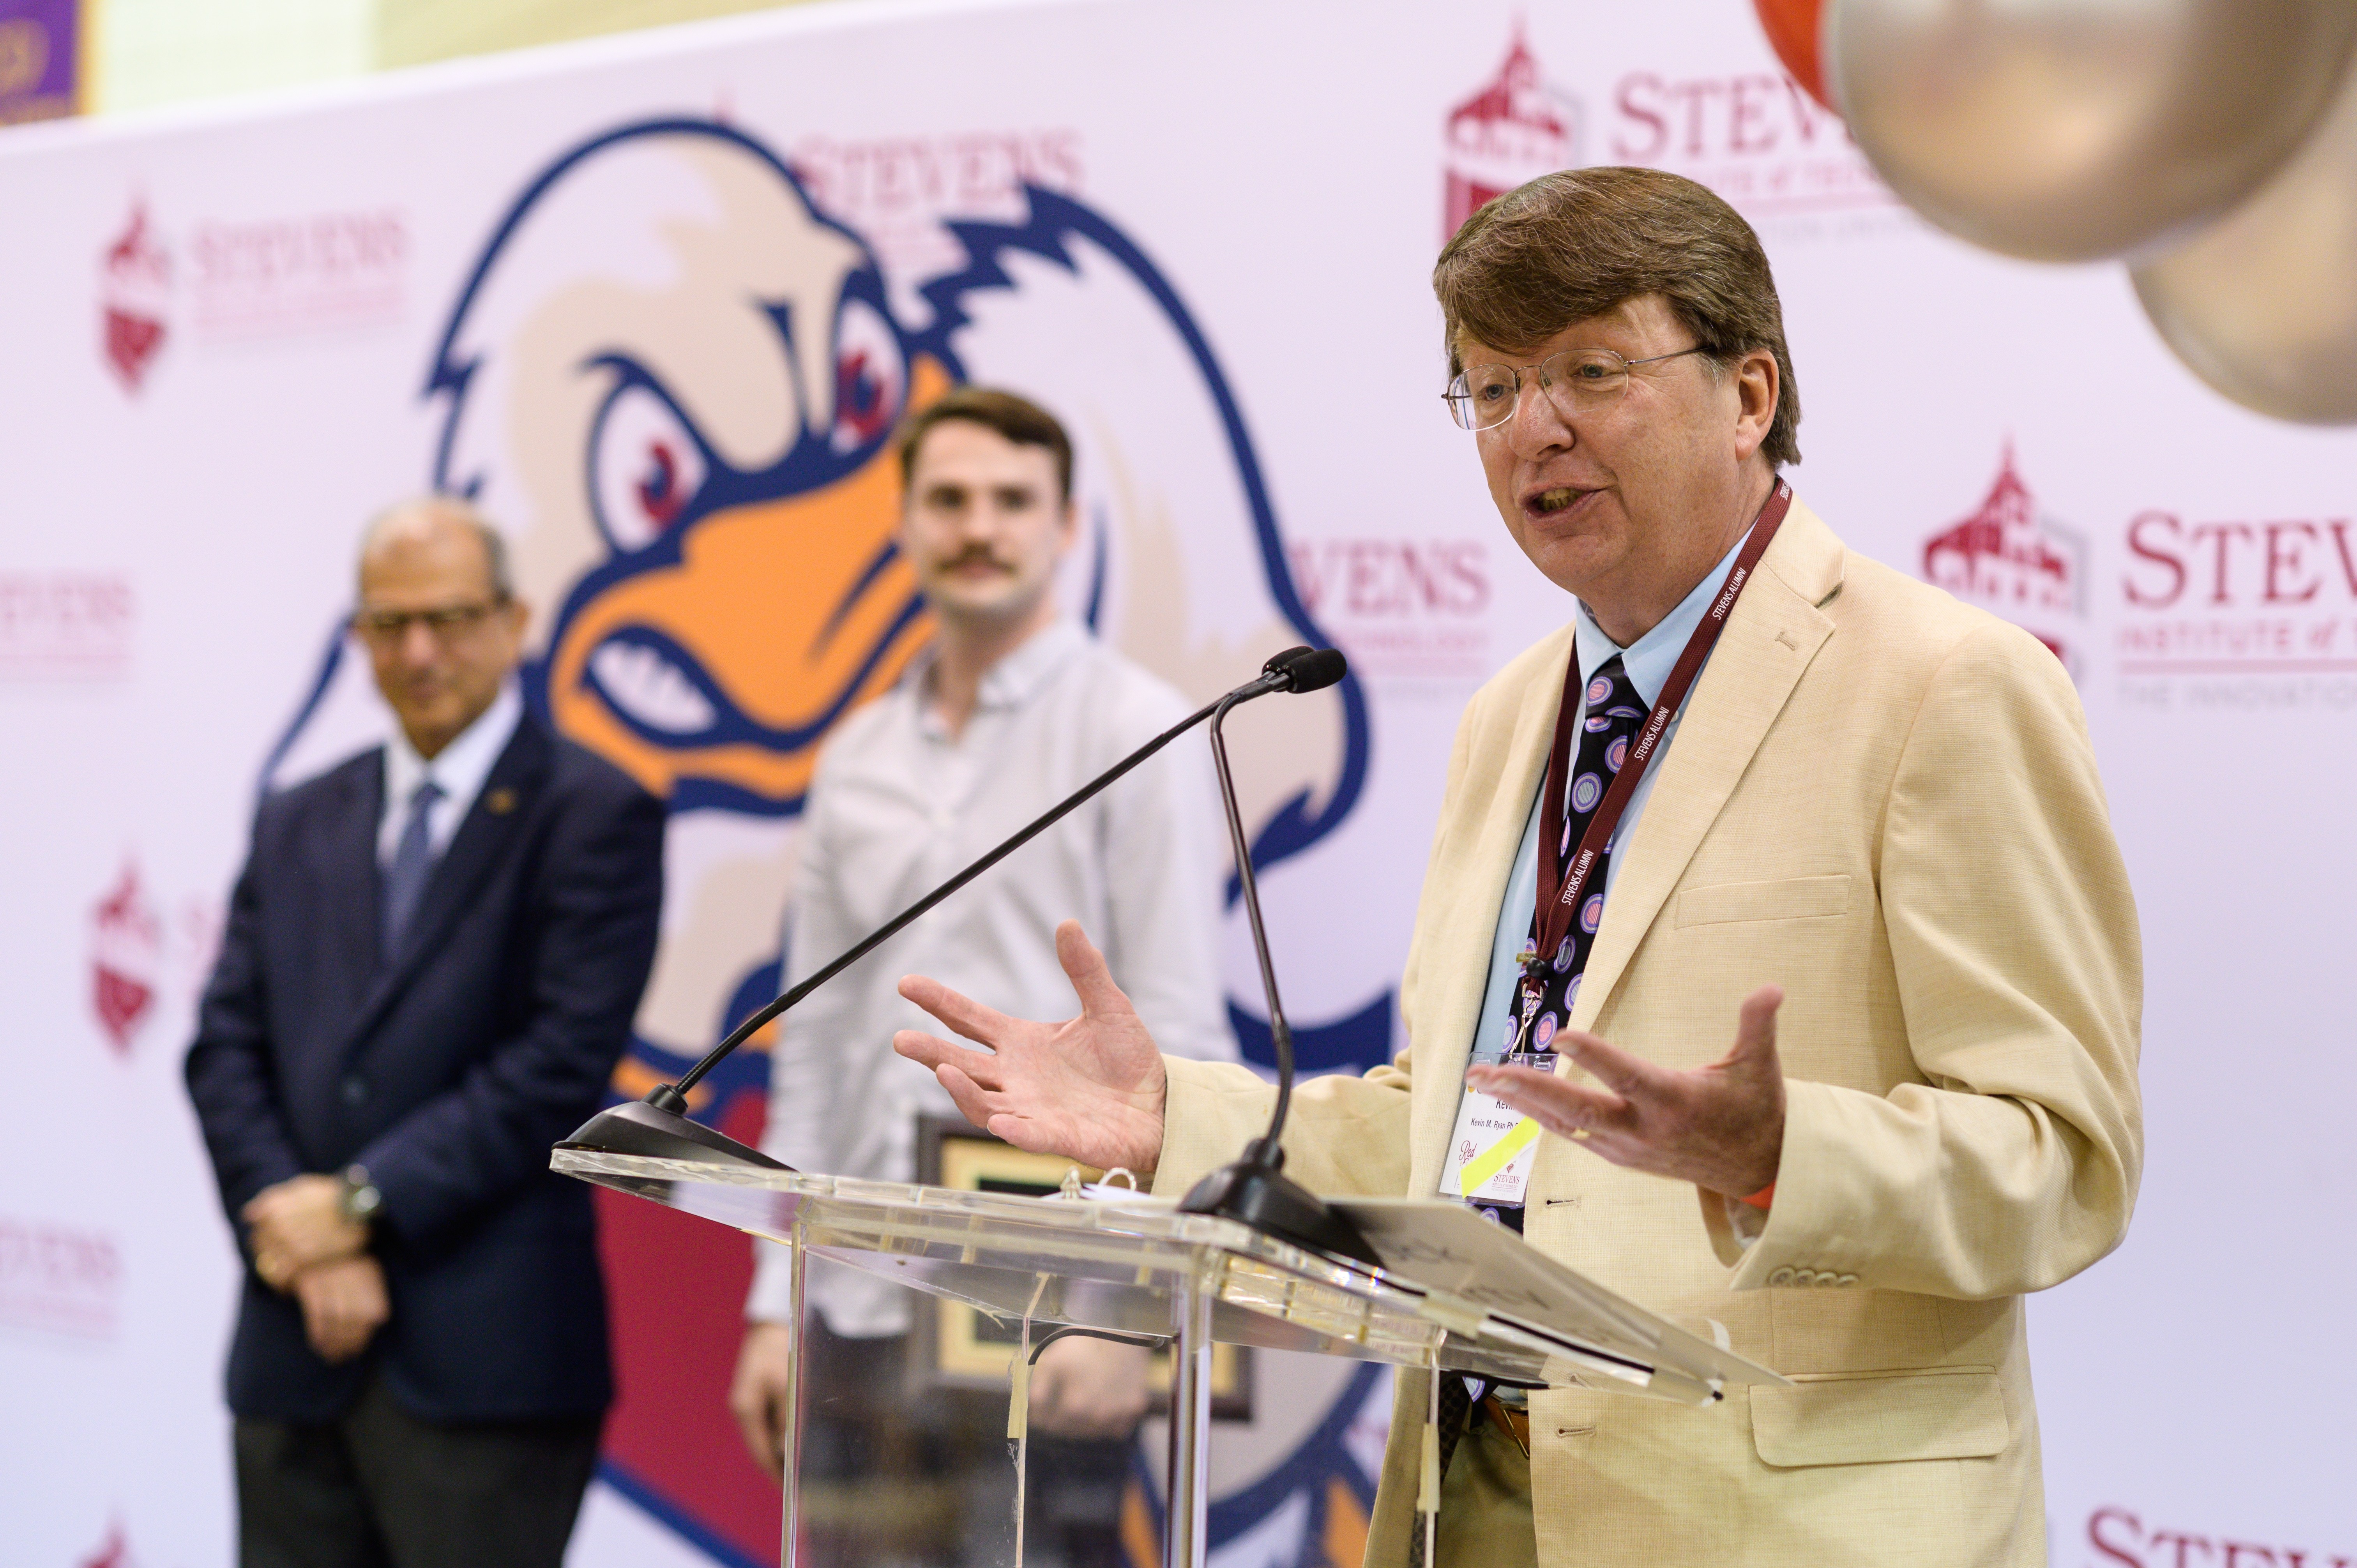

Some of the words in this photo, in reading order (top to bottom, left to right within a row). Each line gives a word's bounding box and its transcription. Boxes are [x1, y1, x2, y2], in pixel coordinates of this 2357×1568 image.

[1712, 591, 1733, 620] STEVENS
[1729, 567, 1746, 594] ALUMNI
[1634, 731, 1656, 761] STEVENS
[1650, 706, 1670, 735] ALUMNI
[1562, 875, 1581, 906] STEVENS
[1574, 849, 1594, 878] ALUMNI
[1471, 1118, 1485, 1127] Kevin
[1486, 1119, 1492, 1128] M.
[1494, 1120, 1505, 1130] Ryan
[1459, 1140, 1477, 1164] Red
[1494, 1174, 1520, 1184] STEVENS
